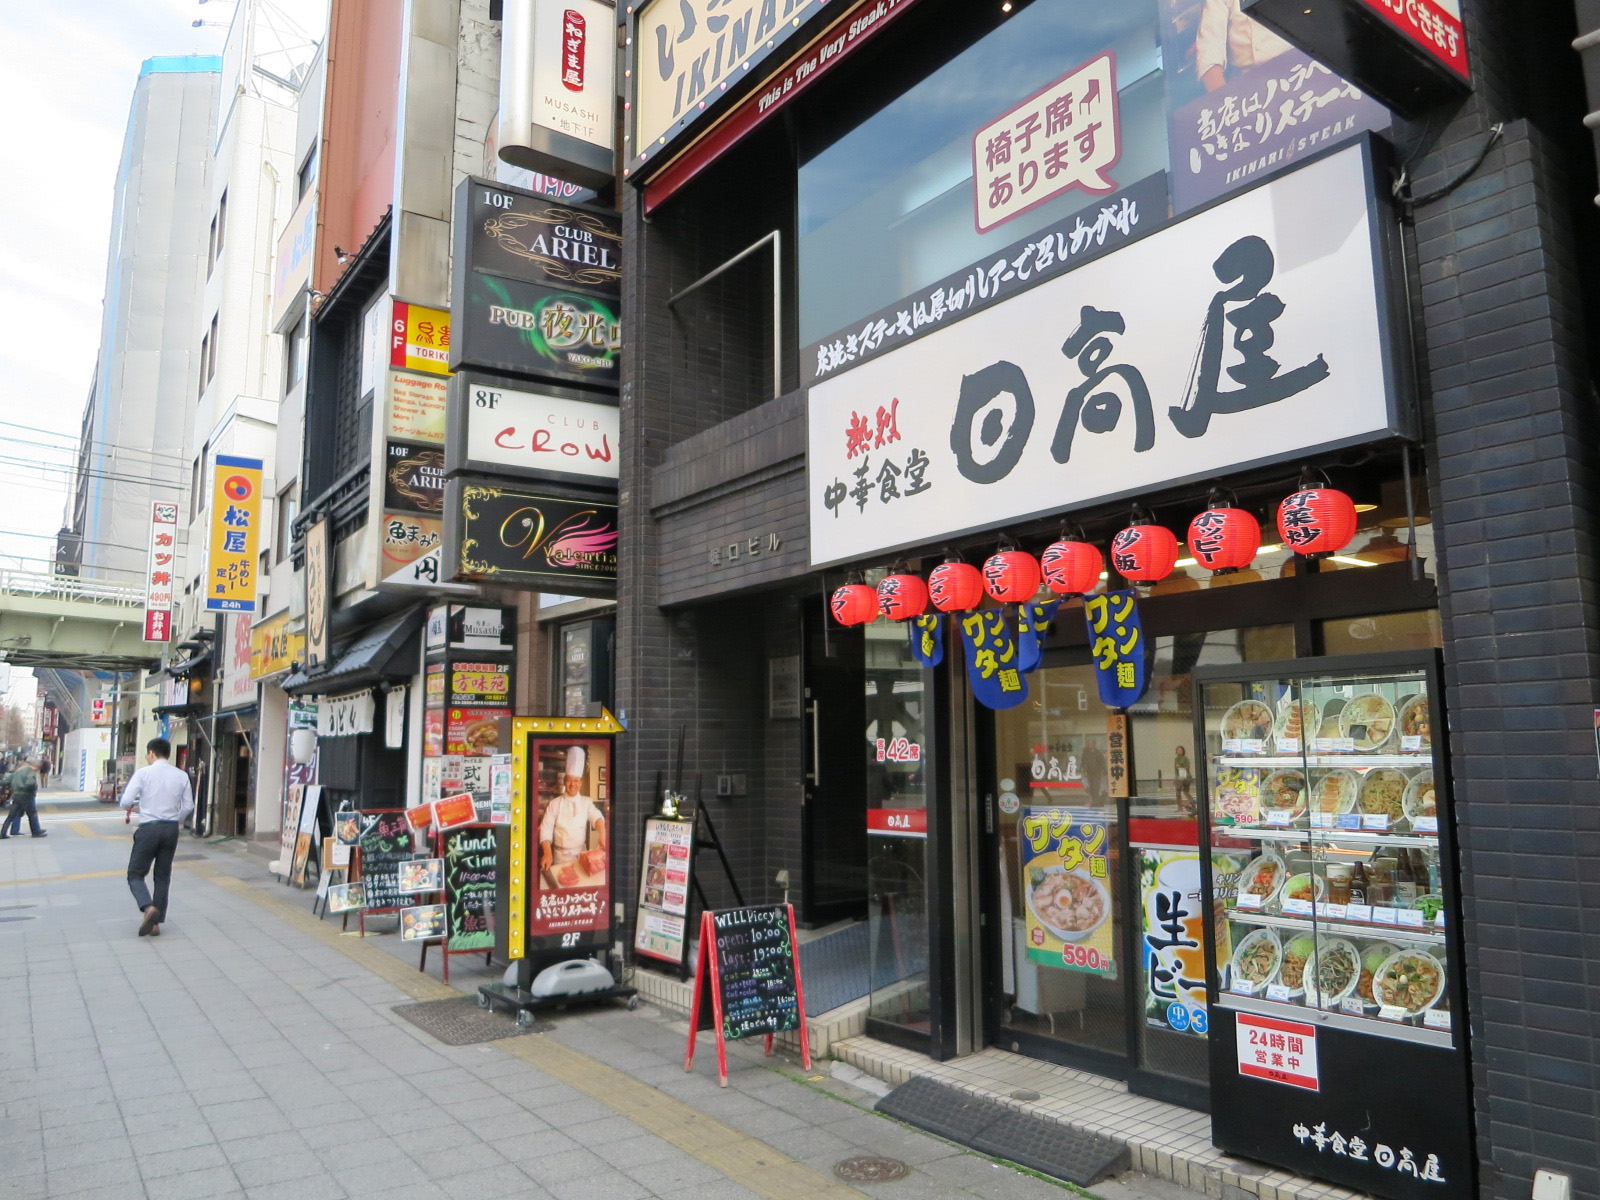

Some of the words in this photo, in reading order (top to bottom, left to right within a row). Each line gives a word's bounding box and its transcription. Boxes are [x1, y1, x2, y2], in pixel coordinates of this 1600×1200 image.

[563, 22, 583, 86] ねぎま屋
[758, 83, 782, 113] This
[782, 77, 793, 95] is
[796, 57, 817, 83] The
[819, 34, 846, 67] Very
[847, 1, 888, 41] Steak,
[543, 95, 600, 123] MUSASHI
[985, 92, 1074, 172] 椅子席
[1225, 148, 1284, 185] IKINARI
[1297, 114, 1356, 151] STEAK
[988, 121, 1102, 209] あります
[483, 191, 514, 210] 10F
[554, 225, 593, 243] CLUB
[529, 234, 616, 270] ARIEL
[489, 304, 536, 330] PUB
[949, 235, 1331, 485] 日高屋
[394, 375, 433, 389] Luggage
[475, 390, 502, 409] 8F
[547, 414, 599, 431] CLUB
[845, 397, 902, 458] 熱烈
[389, 446, 409, 457] 10F
[494, 426, 612, 462] CROW
[823, 447, 932, 519] 中華食堂
[222, 505, 250, 553] 松屋
[385, 521, 440, 548] 魚まみれ
[1192, 511, 1227, 563] ホッピー
[151, 533, 173, 586] カツ丼
[1112, 528, 1142, 572] 炒飯
[215, 568, 227, 594] 定食
[228, 563, 238, 590] カレー
[239, 559, 250, 587] 牛めし
[983, 555, 1009, 596] 生ビール
[149, 592, 171, 602] 490円
[221, 600, 242, 609] 24h
[831, 586, 852, 622] サワー
[876, 578, 901, 616] 餃子
[152, 610, 166, 640] お弁当
[1085, 594, 1134, 634] ワン
[962, 612, 1005, 648] ワン
[974, 638, 1015, 680] タン
[1092, 626, 1139, 671] タン
[497, 664, 509, 673] 2F
[1031, 754, 1082, 780] 日高屋
[1108, 732, 1125, 780] 営業中
[456, 829, 497, 851] Lunch
[1024, 809, 1072, 853] ワン
[1058, 823, 1106, 871] タン
[1089, 855, 1108, 878] 麺
[715, 911, 747, 928] WILL
[561, 932, 581, 947] 2F
[751, 928, 781, 943] 10:00
[752, 946, 783, 962] 19:00
[1062, 943, 1110, 971] 590円
[1172, 1003, 1185, 1021] 中
[1248, 1029, 1304, 1055] 24時間
[1254, 1049, 1301, 1070] 営業中
[1292, 1121, 1368, 1161] 中華食堂
[1373, 1143, 1446, 1183] 日高屋
